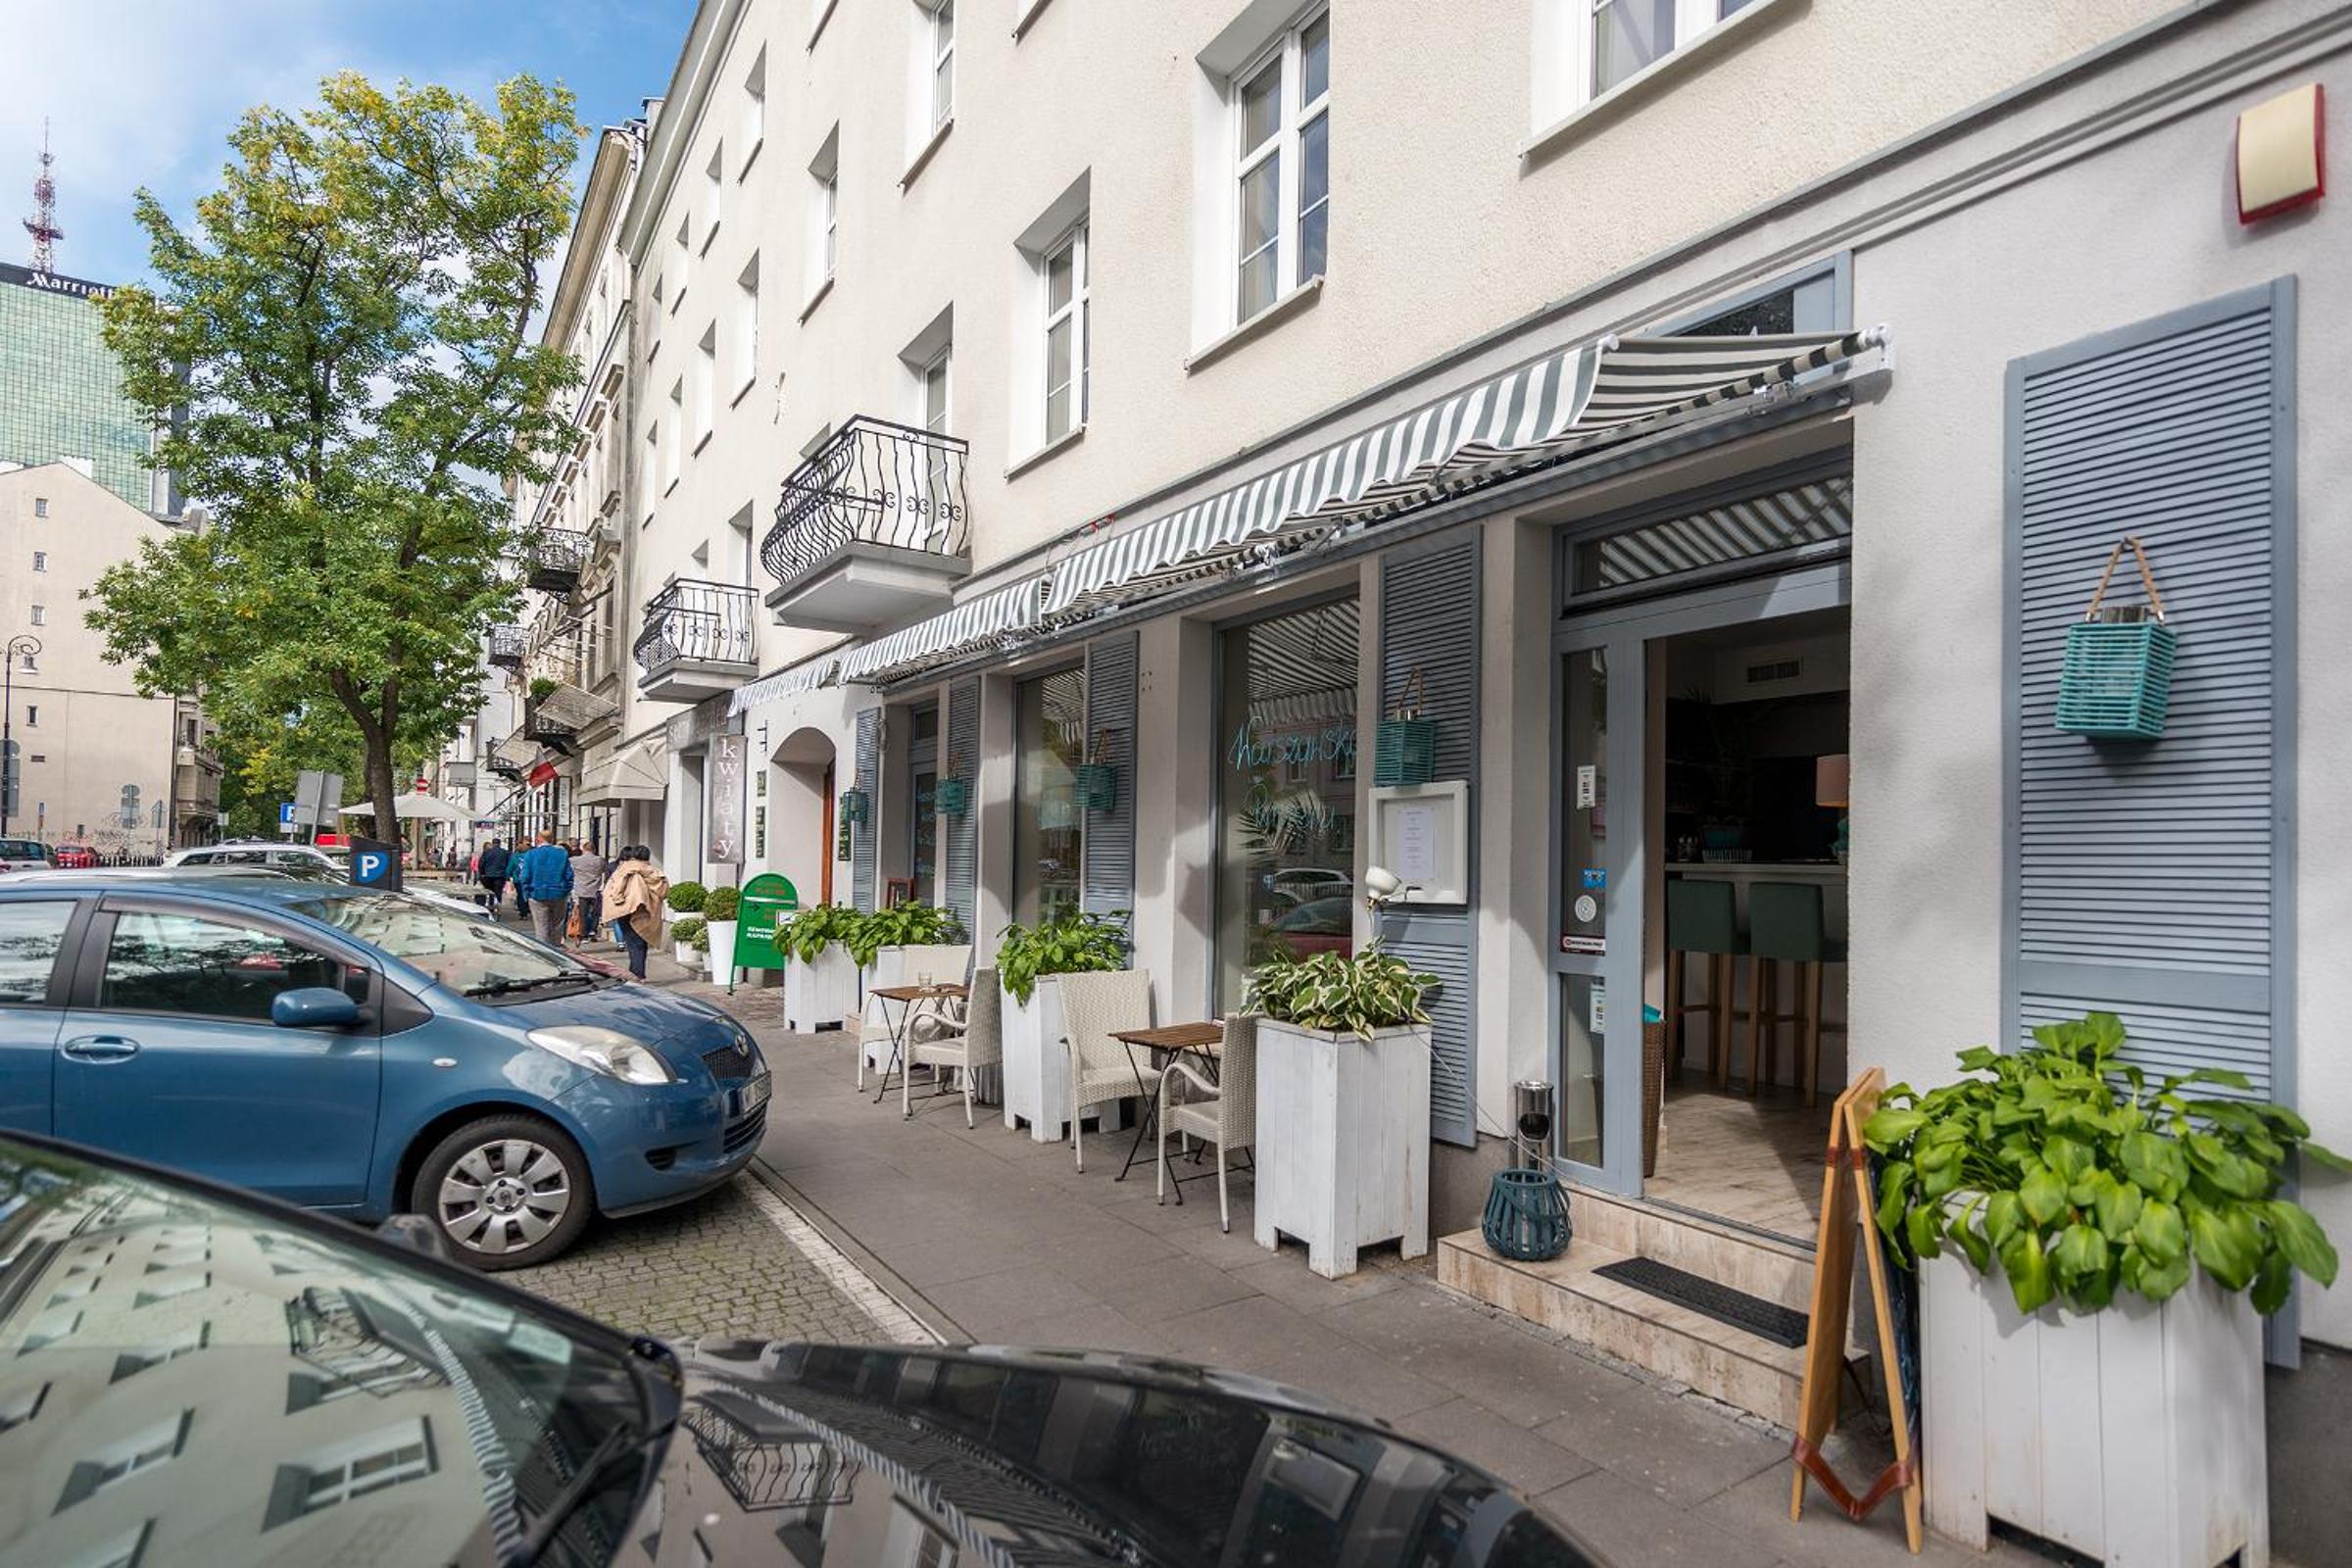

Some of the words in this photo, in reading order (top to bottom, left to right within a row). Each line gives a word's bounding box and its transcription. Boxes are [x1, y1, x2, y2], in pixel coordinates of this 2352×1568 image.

[26, 272, 114, 298] Marriott
[717, 738, 739, 858] kwiaty
[361, 856, 380, 878] P
